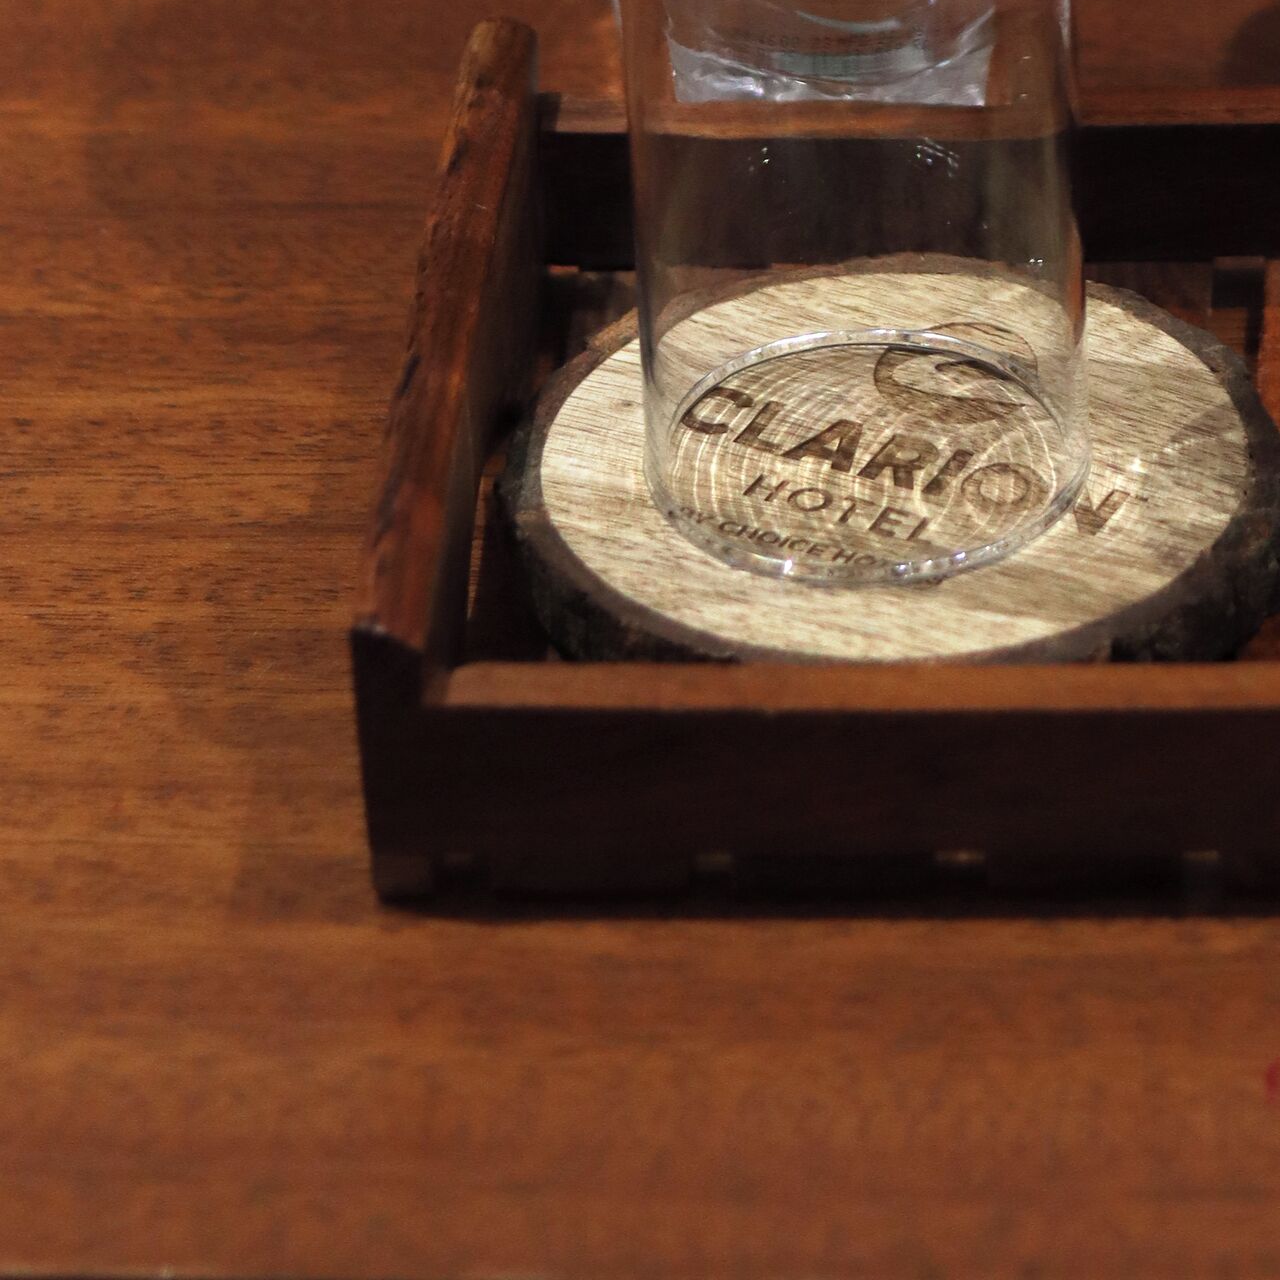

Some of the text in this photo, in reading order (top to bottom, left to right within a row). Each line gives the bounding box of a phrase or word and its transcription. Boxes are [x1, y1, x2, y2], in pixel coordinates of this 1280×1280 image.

[680, 386, 1130, 537] CLARION
[718, 521, 827, 557] CHOICE
[742, 473, 932, 542] HOTEL
